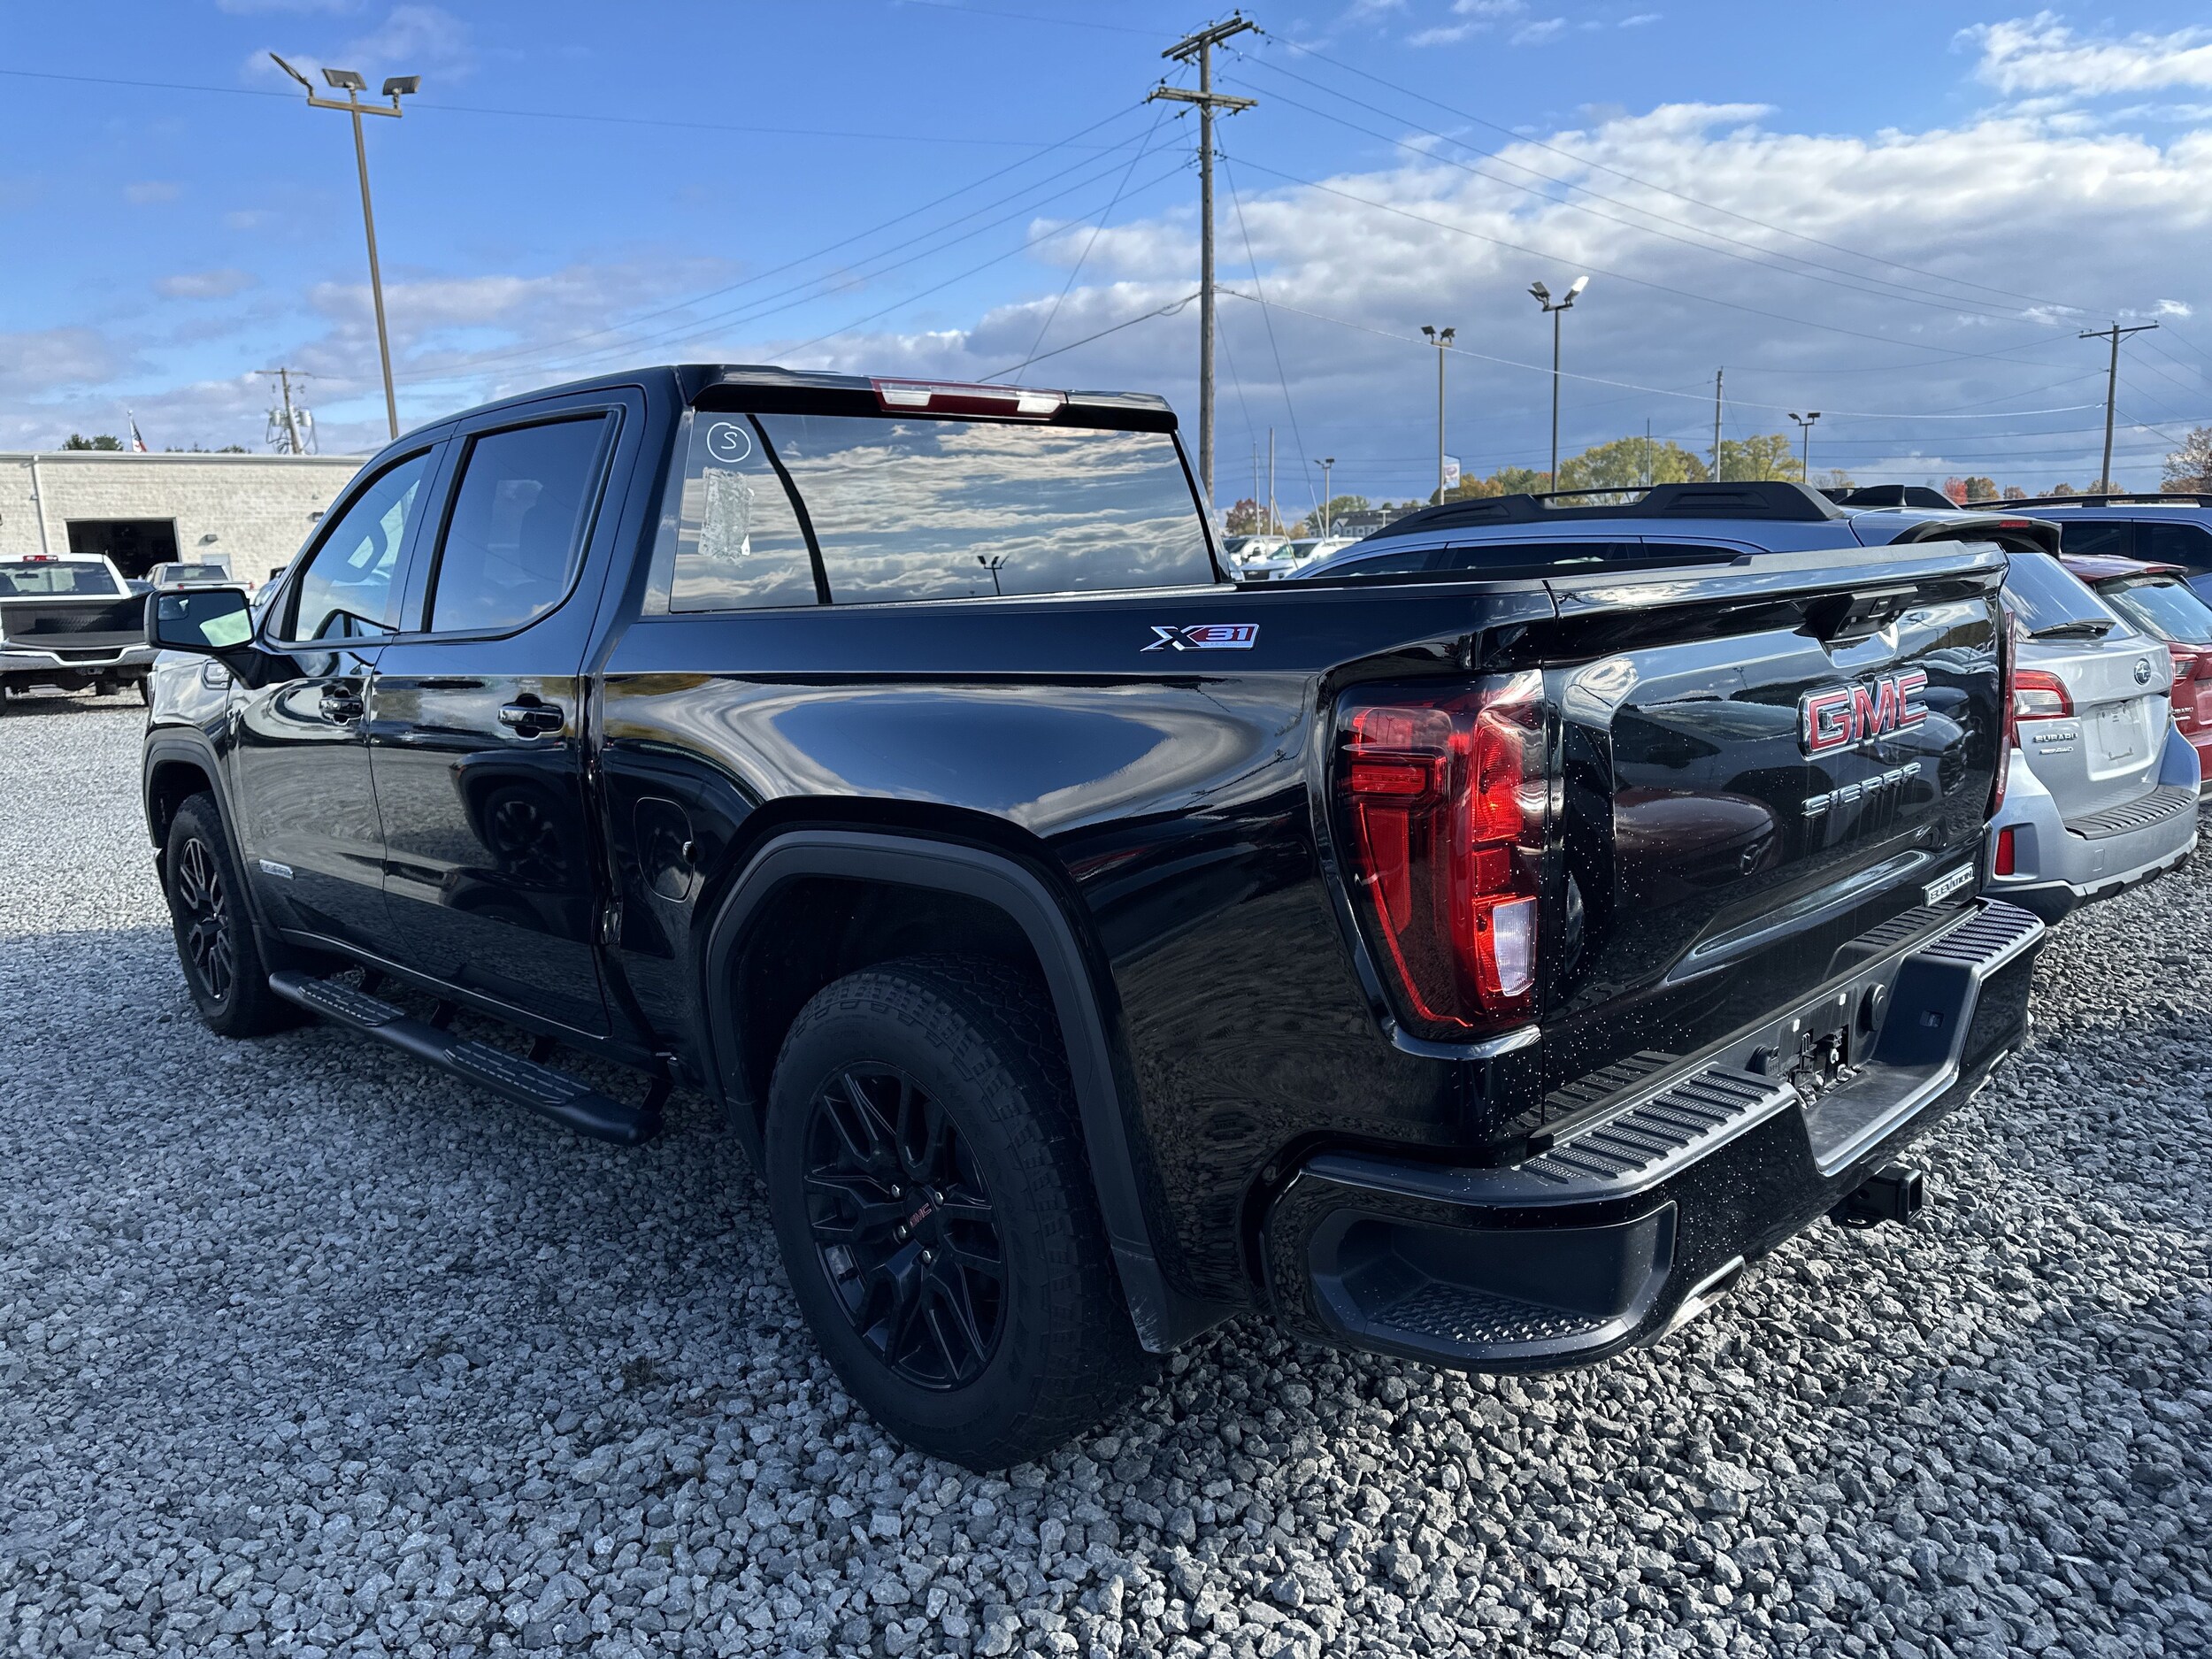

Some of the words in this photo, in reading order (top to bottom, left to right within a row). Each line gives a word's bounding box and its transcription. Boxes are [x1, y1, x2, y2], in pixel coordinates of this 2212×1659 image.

[1140, 624, 1260, 651] X31
[1797, 664, 1929, 761] GMC
[2033, 733, 2078, 742] SUBARU
[1801, 762, 1921, 818] SIERRA
[910, 1202, 933, 1228] GMC
